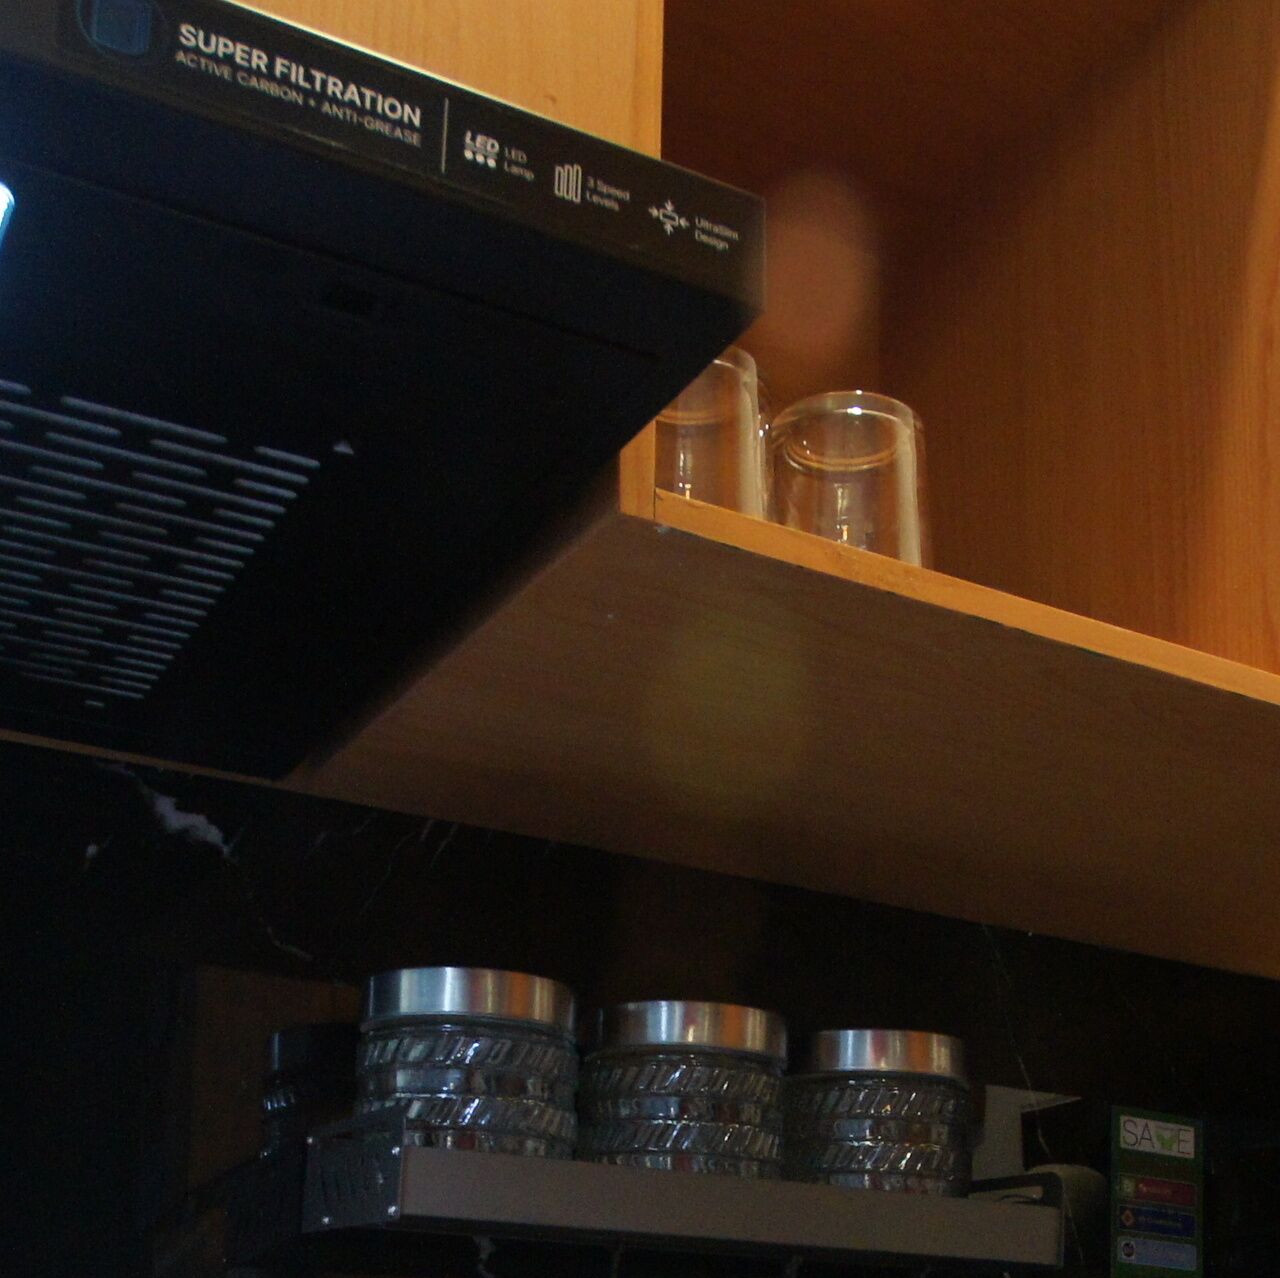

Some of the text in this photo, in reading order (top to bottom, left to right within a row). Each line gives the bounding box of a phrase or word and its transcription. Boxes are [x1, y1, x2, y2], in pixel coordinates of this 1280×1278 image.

[174, 50, 232, 82] ACTIVE
[237, 71, 304, 107] CARBON
[321, 101, 421, 148] ANTI-GREASE
[178, 23, 421, 129] SUPER FILTRATION
[464, 130, 500, 154] LED
